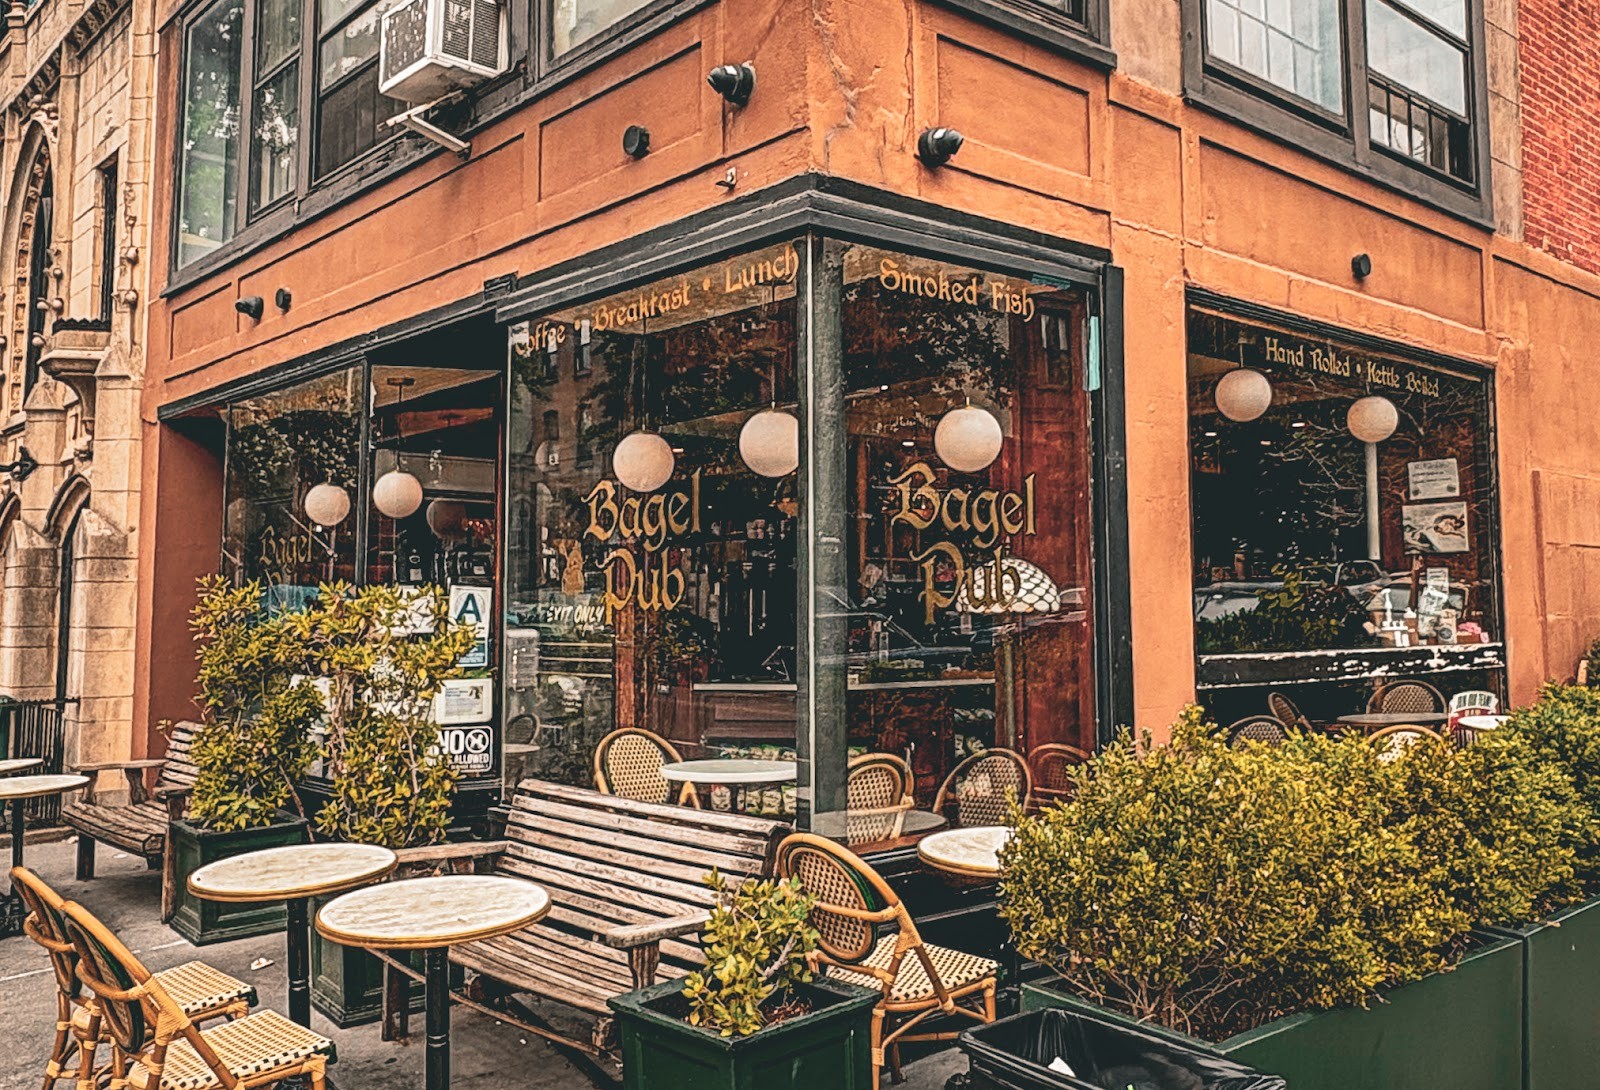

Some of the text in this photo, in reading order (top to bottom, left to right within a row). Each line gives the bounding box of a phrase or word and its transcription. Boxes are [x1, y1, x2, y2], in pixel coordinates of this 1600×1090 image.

[592, 279, 691, 333] Breakfast
[725, 244, 800, 293] Lunch
[879, 259, 1035, 322] Smoked Fish
[1264, 336, 1439, 398] Hand Rolled Kettle Boiled
[580, 466, 701, 552] Bagel
[887, 461, 1037, 549] Bagel
[456, 593, 482, 623] A
[574, 604, 605, 624] ONLY
[595, 546, 685, 625] Pub
[909, 541, 1021, 625] Pub
[436, 729, 465, 755] NO
[454, 753, 490, 764] ALLOWED
